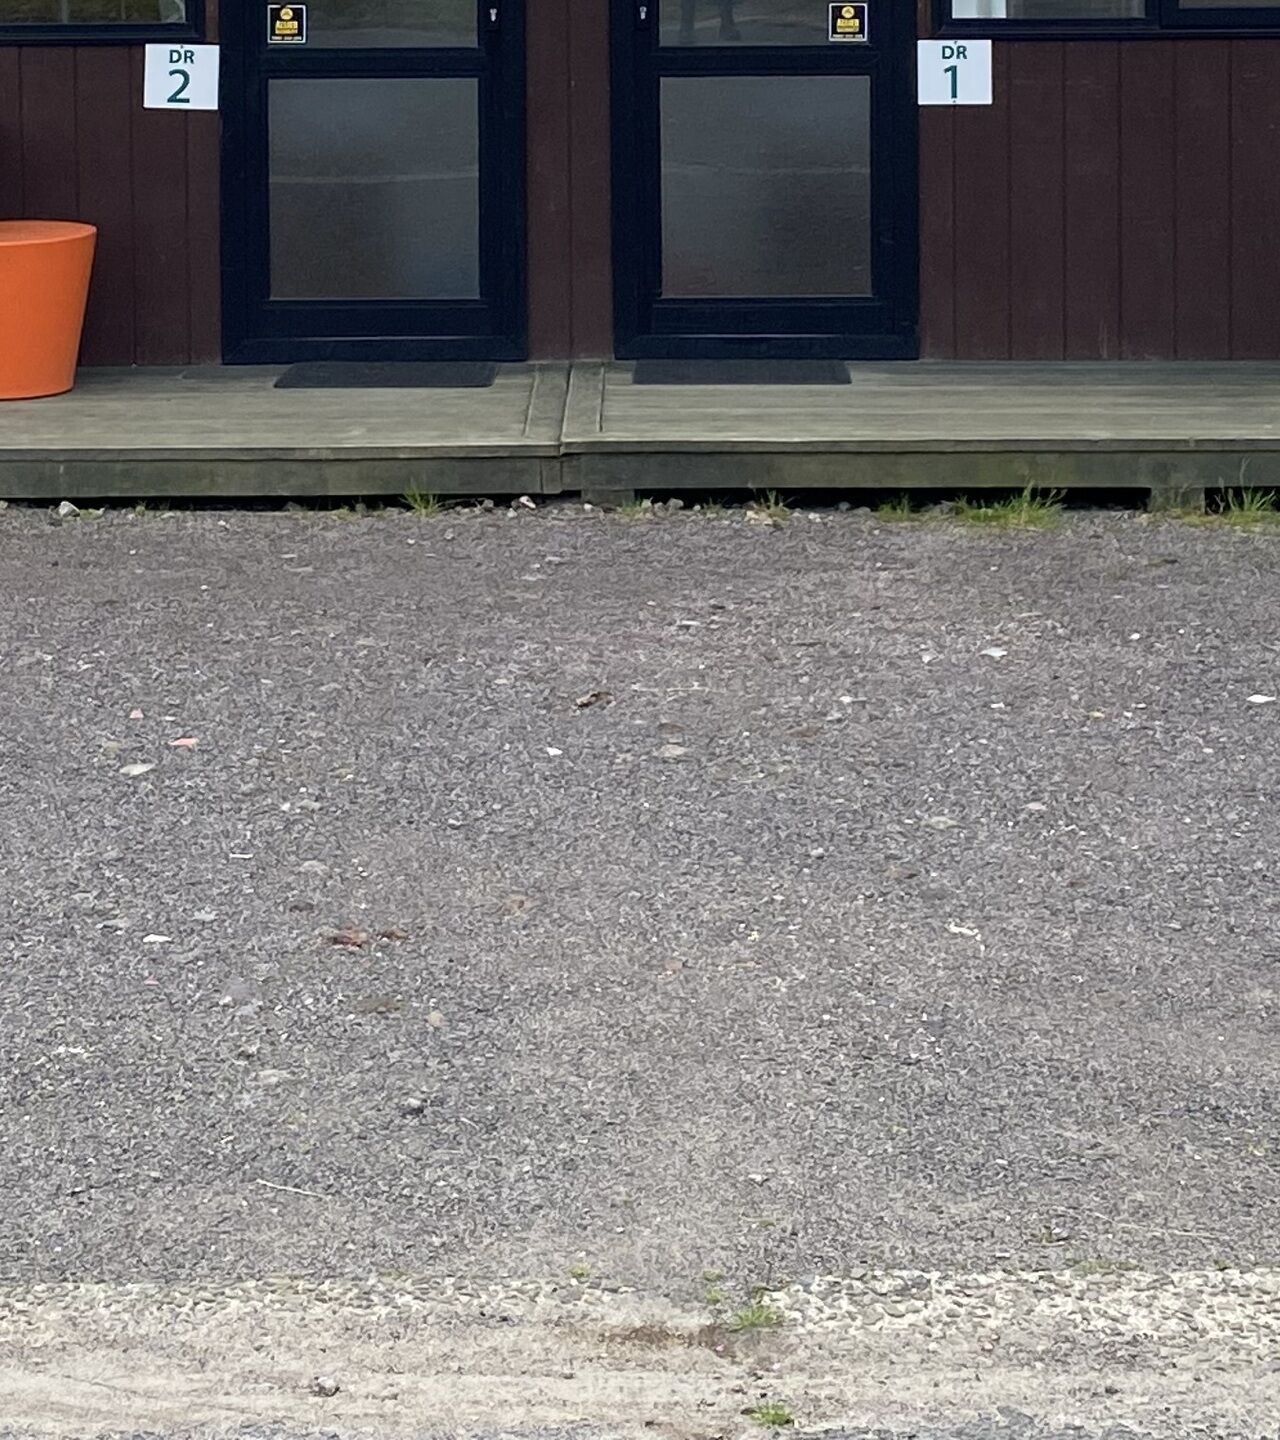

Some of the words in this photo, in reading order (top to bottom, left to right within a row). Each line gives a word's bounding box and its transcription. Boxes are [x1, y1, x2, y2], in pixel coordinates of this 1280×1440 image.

[169, 49, 195, 64] DR
[941, 45, 967, 60] DR
[167, 68, 191, 103] 2
[943, 65, 958, 99] 1
